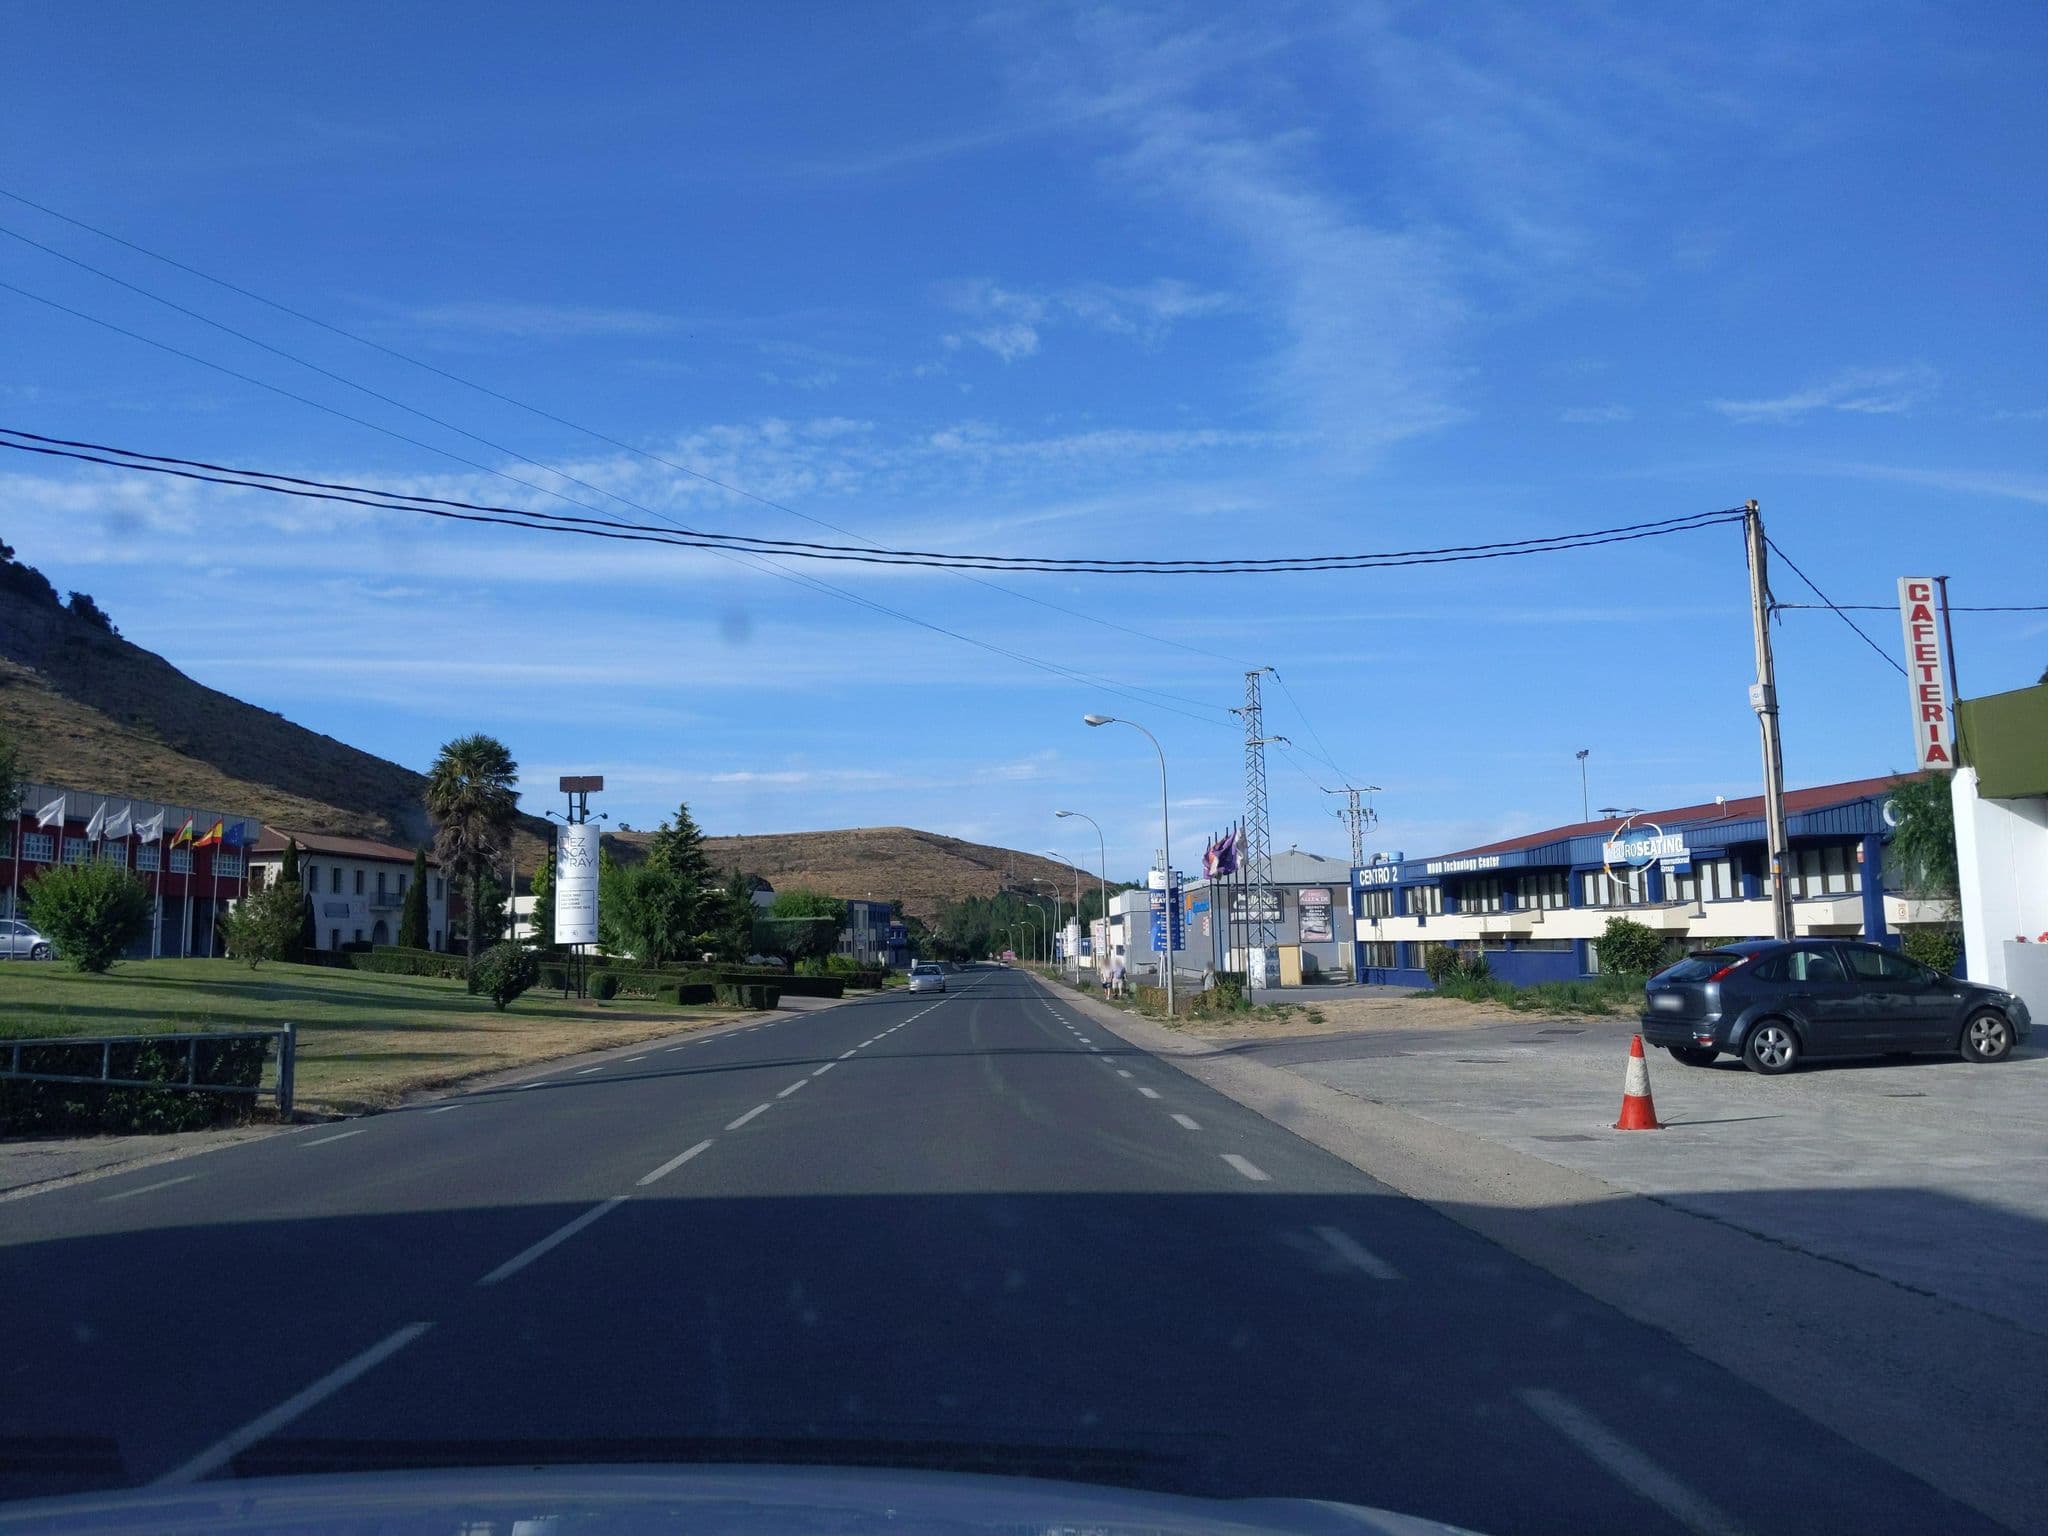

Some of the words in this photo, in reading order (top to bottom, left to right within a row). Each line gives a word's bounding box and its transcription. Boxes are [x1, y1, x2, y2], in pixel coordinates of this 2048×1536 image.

[1908, 583, 1950, 762] CAFETERIA
[570, 837, 586, 847] EZ
[569, 858, 594, 868] RAY
[1443, 858, 1477, 873] Technology
[1478, 855, 1500, 869] Center
[1359, 867, 1390, 886] CENTRO
[1392, 866, 1398, 882] 2
